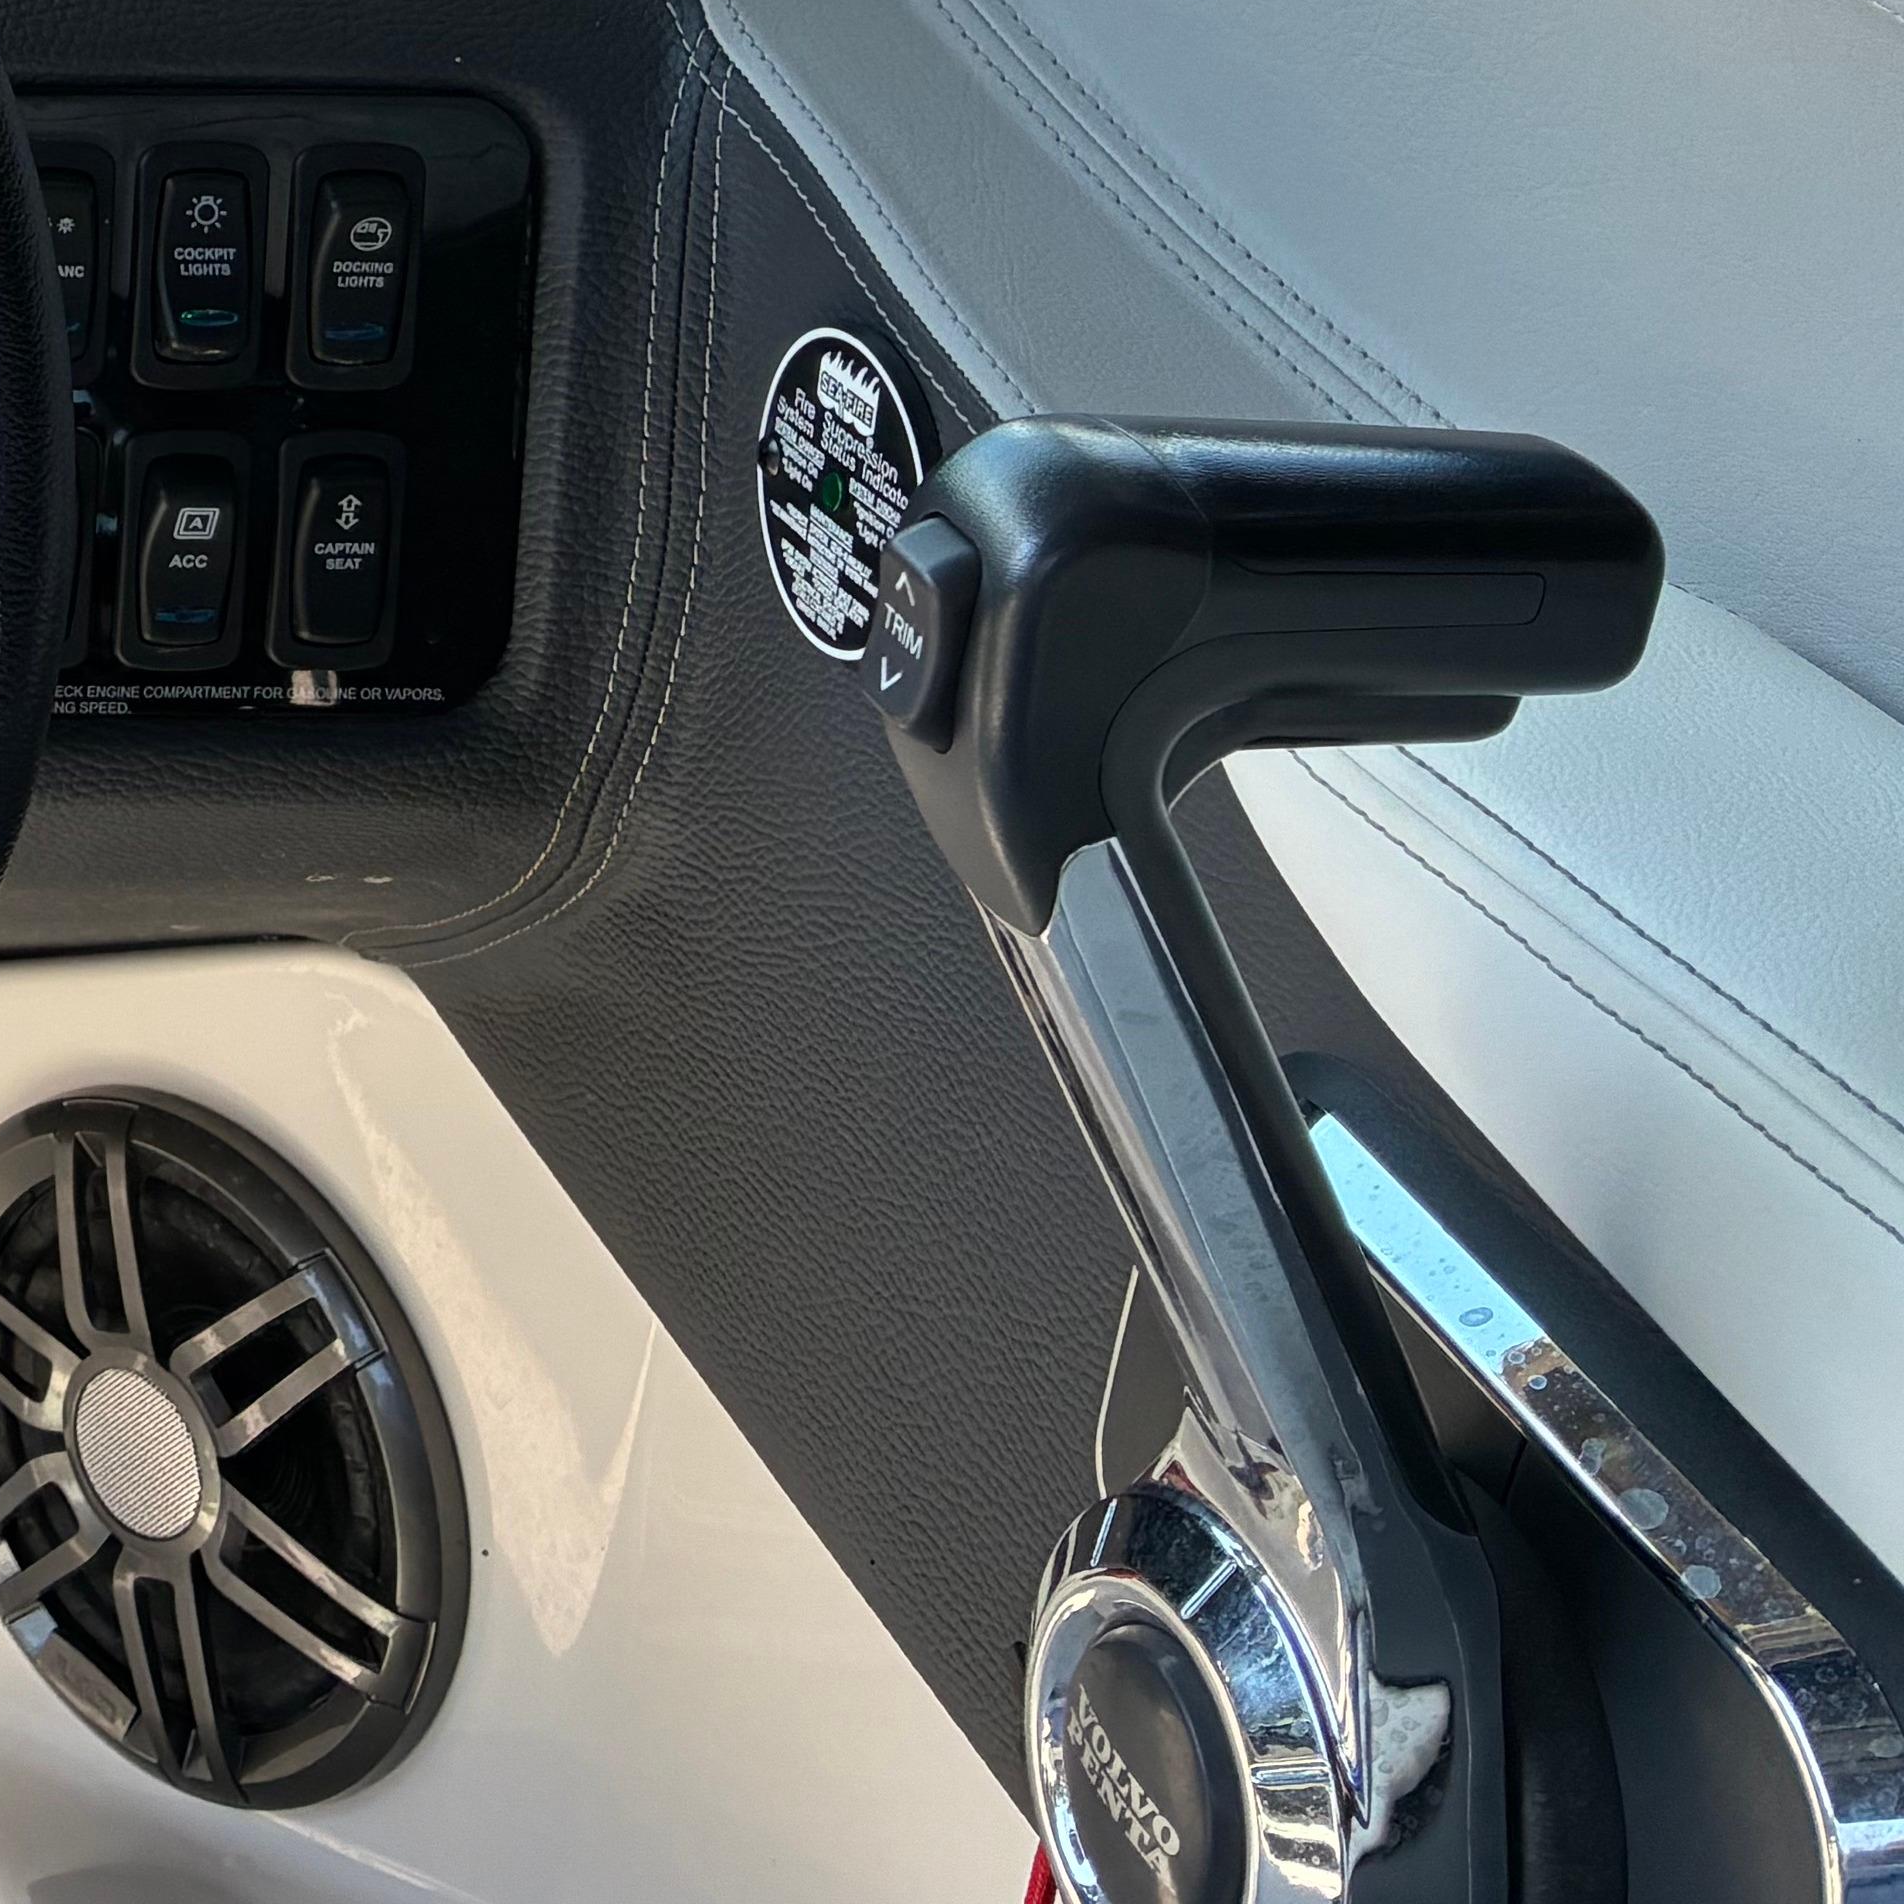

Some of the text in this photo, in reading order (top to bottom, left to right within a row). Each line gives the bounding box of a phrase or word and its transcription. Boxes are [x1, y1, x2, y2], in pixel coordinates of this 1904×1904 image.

[174, 247, 236, 261] COCKPIT
[180, 263, 231, 277] LIGHTS
[333, 261, 393, 274] DOCKING
[337, 276, 384, 288] LIGHTS
[795, 387, 816, 420] Fire
[314, 542, 375, 555] CAPTAIN
[169, 554, 208, 569] ACC
[326, 558, 363, 570] SEAT
[884, 602, 923, 660] TRIM
[87, 685, 140, 699] ENGINE
[143, 685, 251, 699] COMPARTMENT
[254, 686, 283, 699] FOR
[360, 688, 382, 700] OR
[79, 702, 132, 715] SPEED.
[1078, 1683, 1180, 1856] VOLVO
[1067, 1706, 1176, 1895] PENTA
